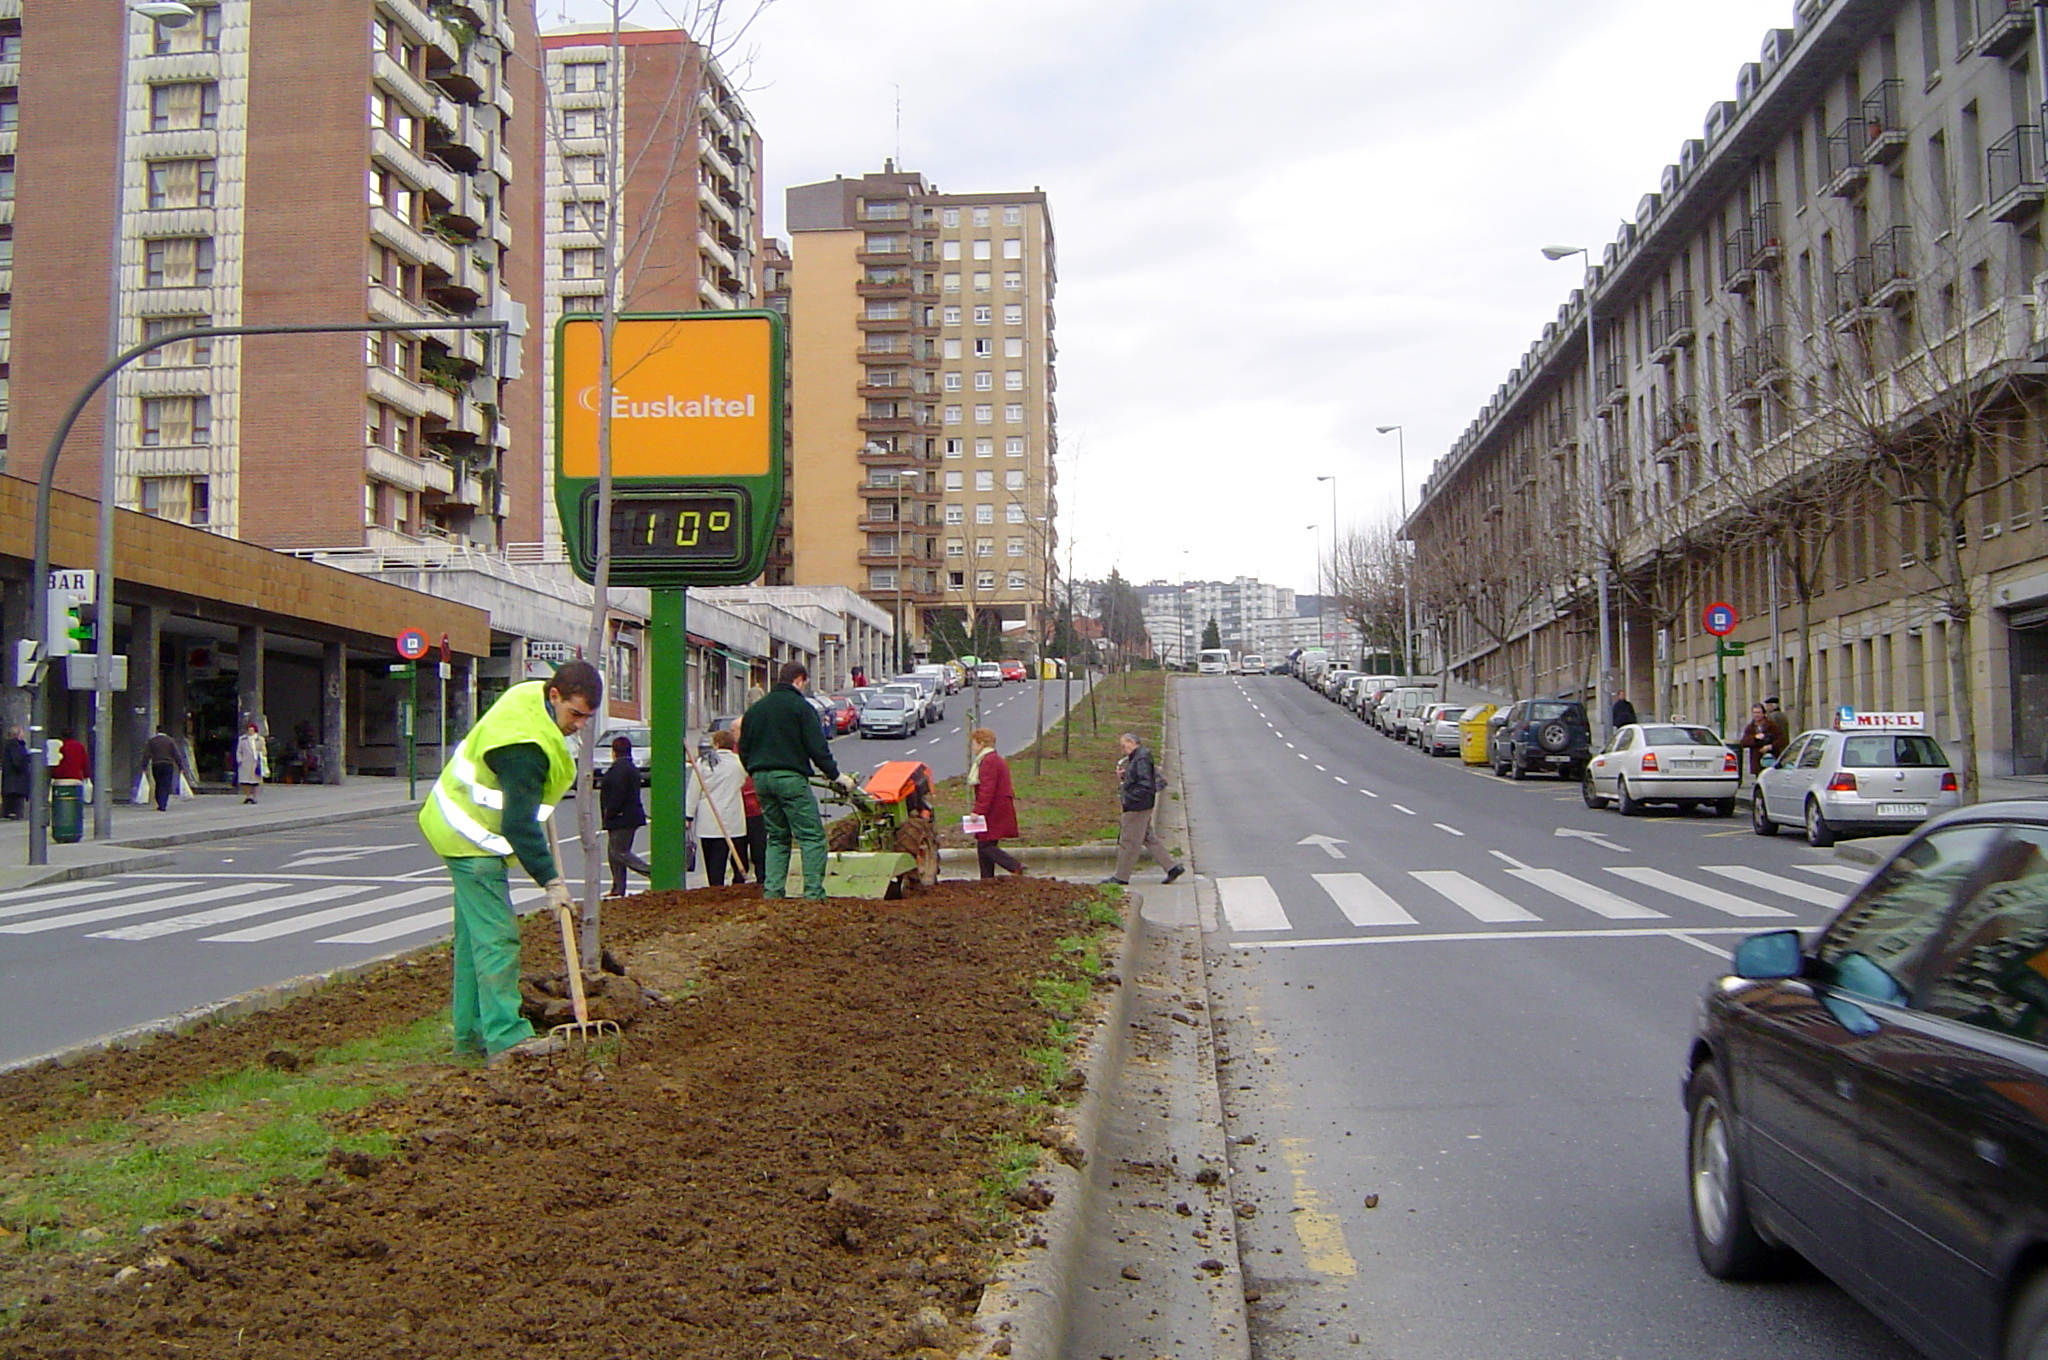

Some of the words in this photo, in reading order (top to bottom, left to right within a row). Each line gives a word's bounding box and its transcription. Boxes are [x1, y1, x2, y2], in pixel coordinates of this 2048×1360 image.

[611, 395, 755, 418] Euskaltel
[48, 574, 85, 589] BAR
[540, 652, 564, 661] CLUB
[1841, 708, 1852, 720] L
